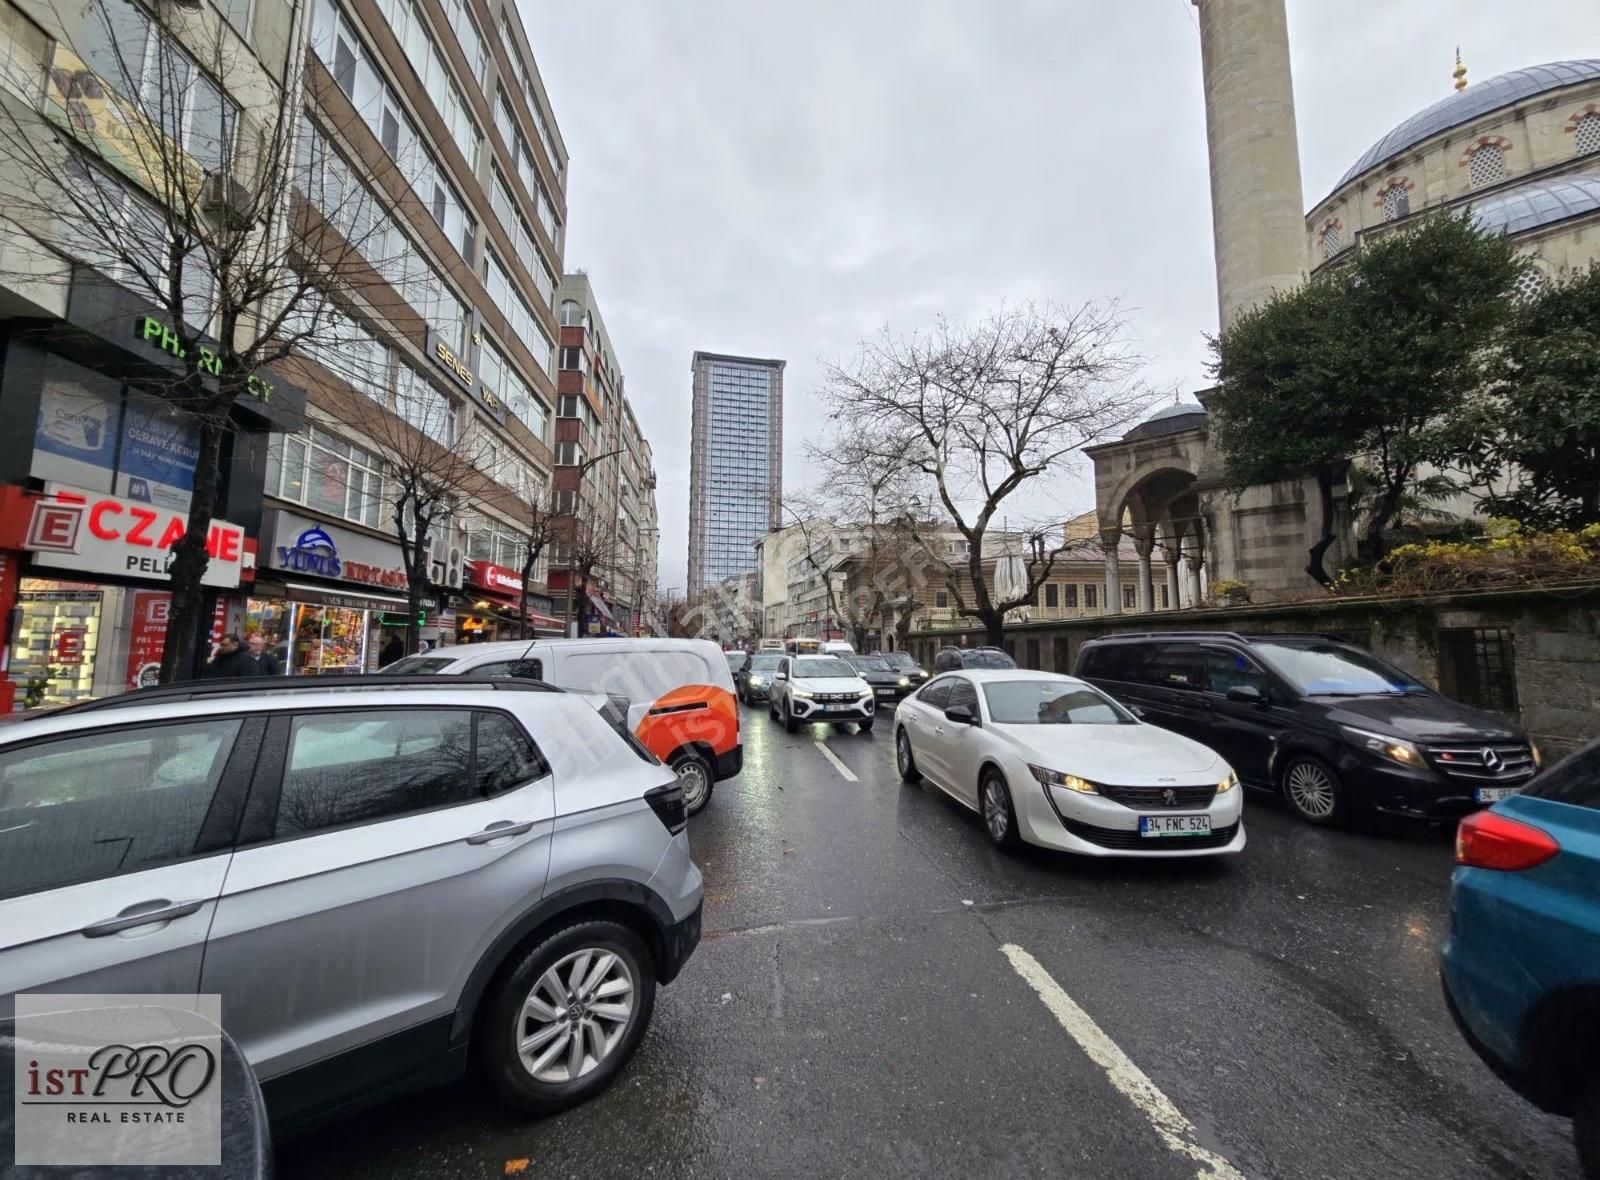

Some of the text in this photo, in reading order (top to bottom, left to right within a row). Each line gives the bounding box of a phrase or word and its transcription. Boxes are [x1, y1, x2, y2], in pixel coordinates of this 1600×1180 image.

[437, 343, 473, 386] SENES
[57, 491, 240, 562] CZANE
[126, 555, 170, 575] PELİ
[1149, 817, 1208, 831] 34 FNC 524
